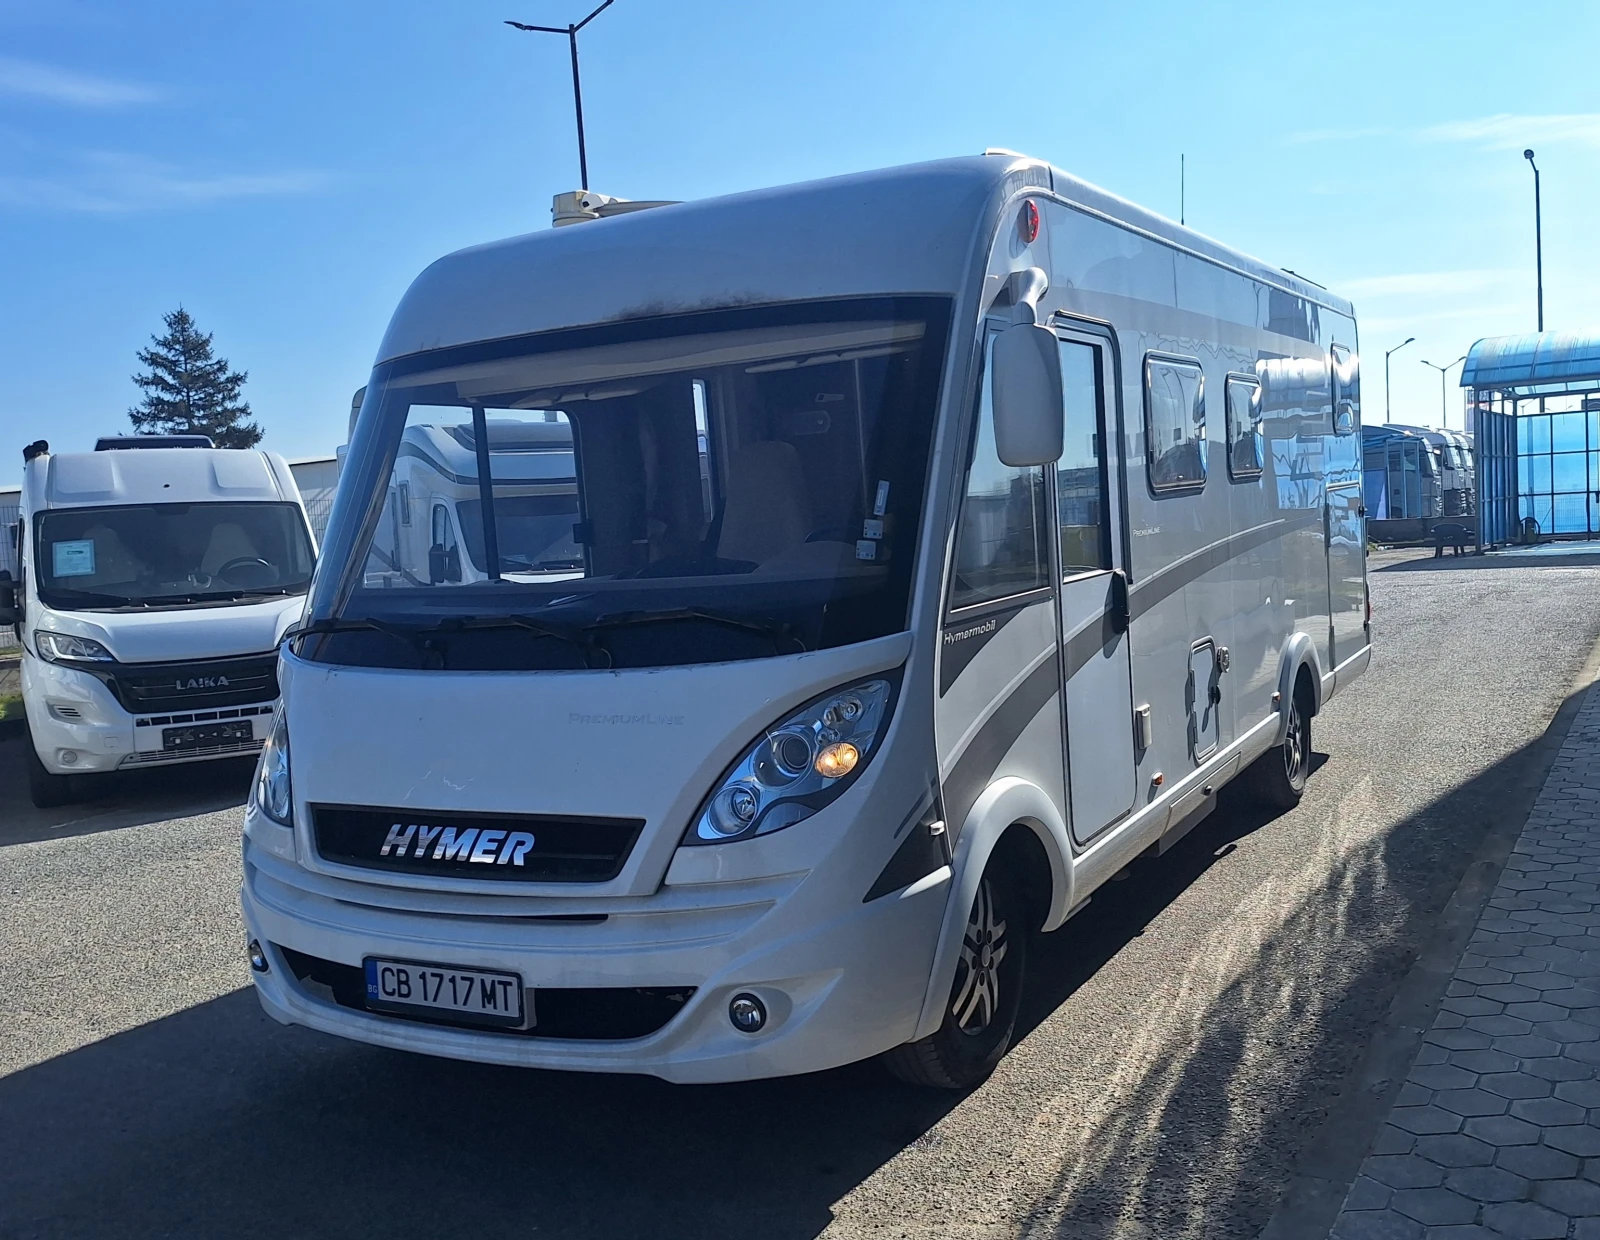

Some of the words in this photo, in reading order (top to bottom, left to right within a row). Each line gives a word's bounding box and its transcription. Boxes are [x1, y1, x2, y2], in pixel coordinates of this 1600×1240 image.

[943, 619, 997, 646] Hymermobil
[175, 675, 230, 690] LAIKA
[379, 823, 536, 867] HYMER
[367, 984, 378, 994] BG
[381, 966, 412, 999] CB
[418, 971, 475, 1007] 1717
[480, 978, 513, 1012] MT
